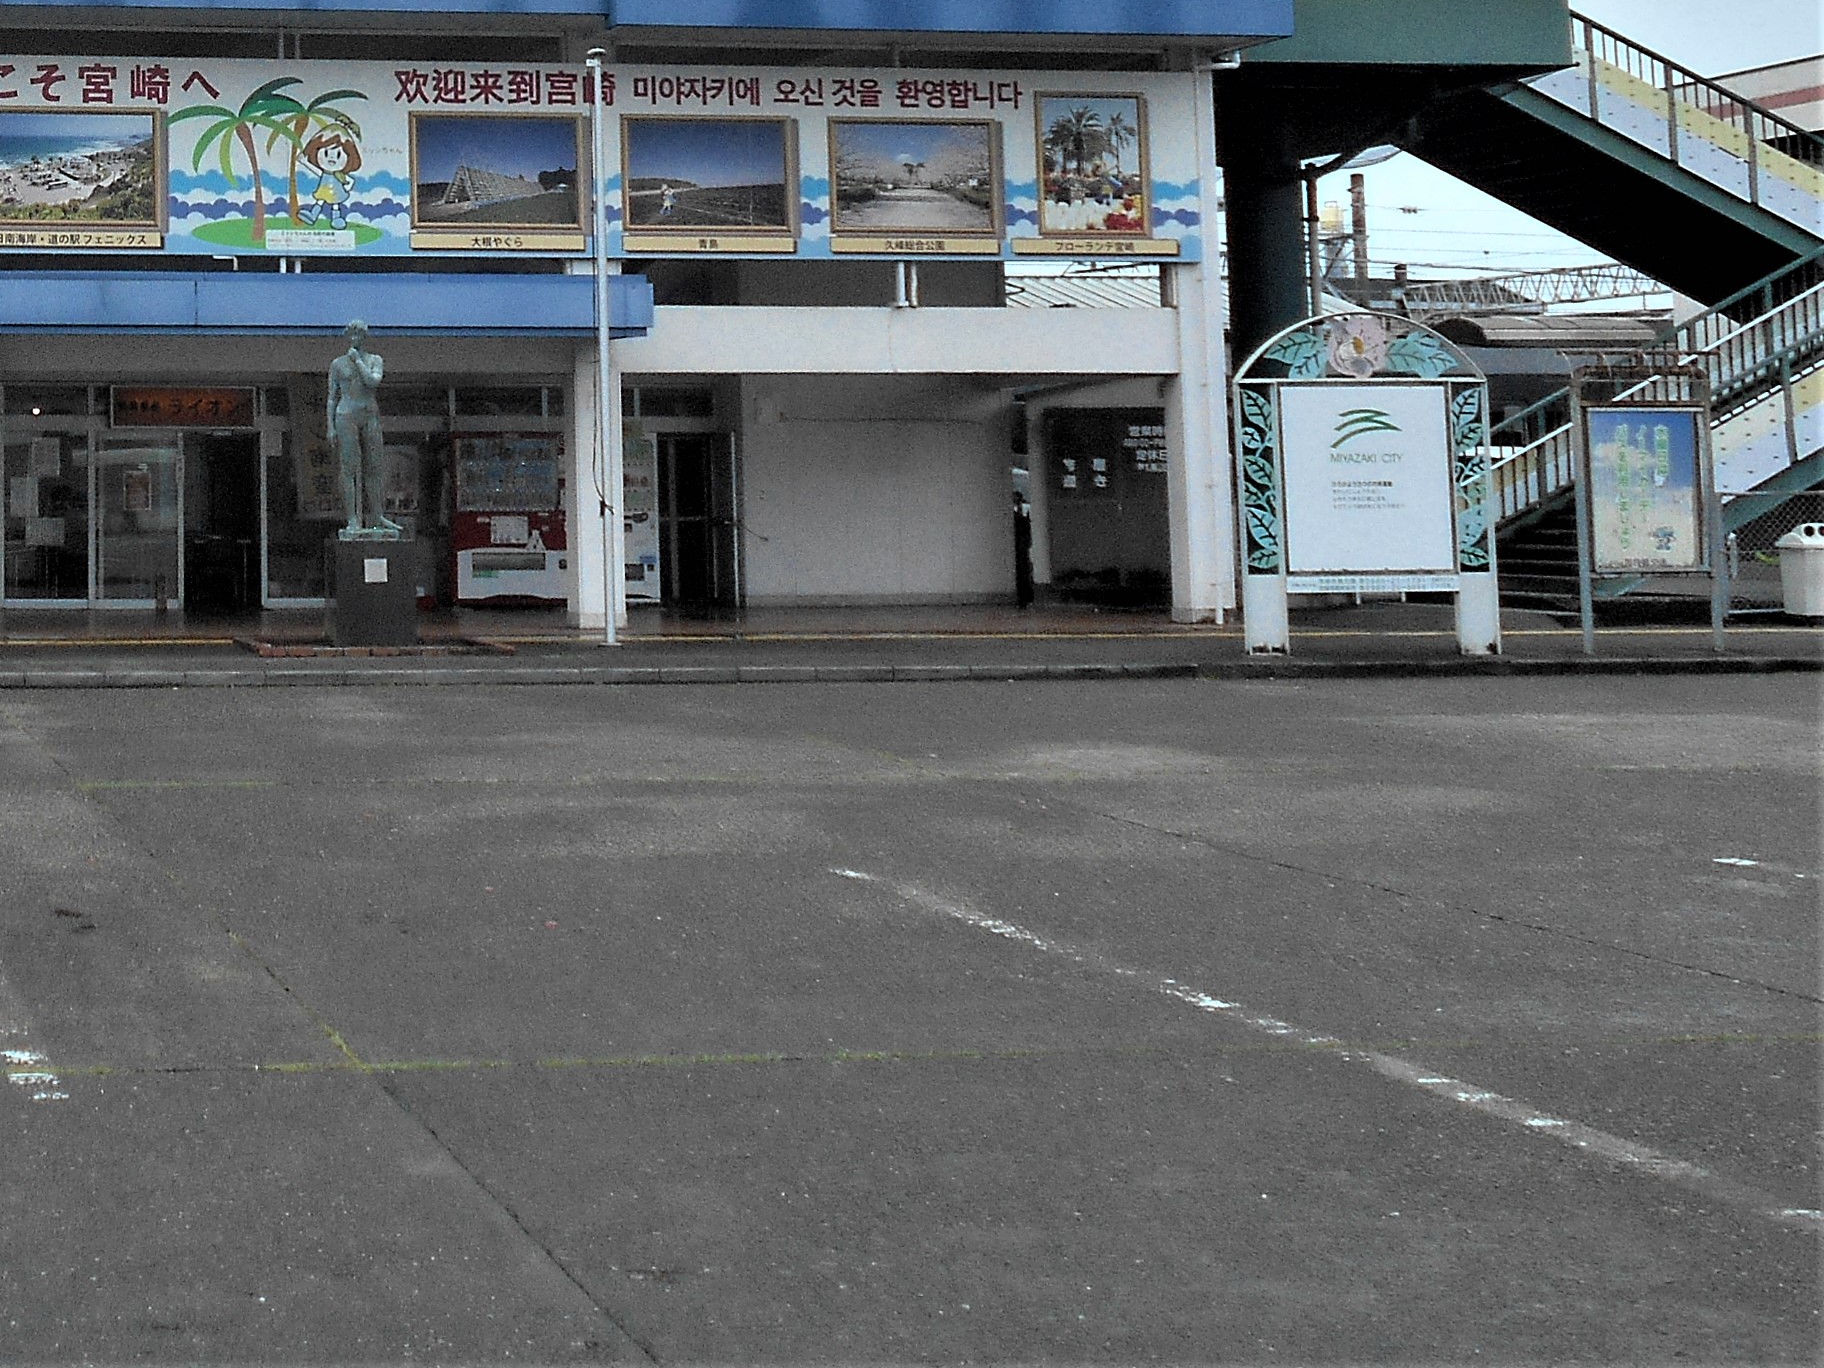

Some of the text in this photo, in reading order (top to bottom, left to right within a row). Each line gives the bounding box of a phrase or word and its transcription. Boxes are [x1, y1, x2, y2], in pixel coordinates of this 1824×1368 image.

[633, 75, 1023, 110] 미야자키에 오신 것을 환영합니다
[1330, 453, 1403, 464] MIYAZAKI CITY
